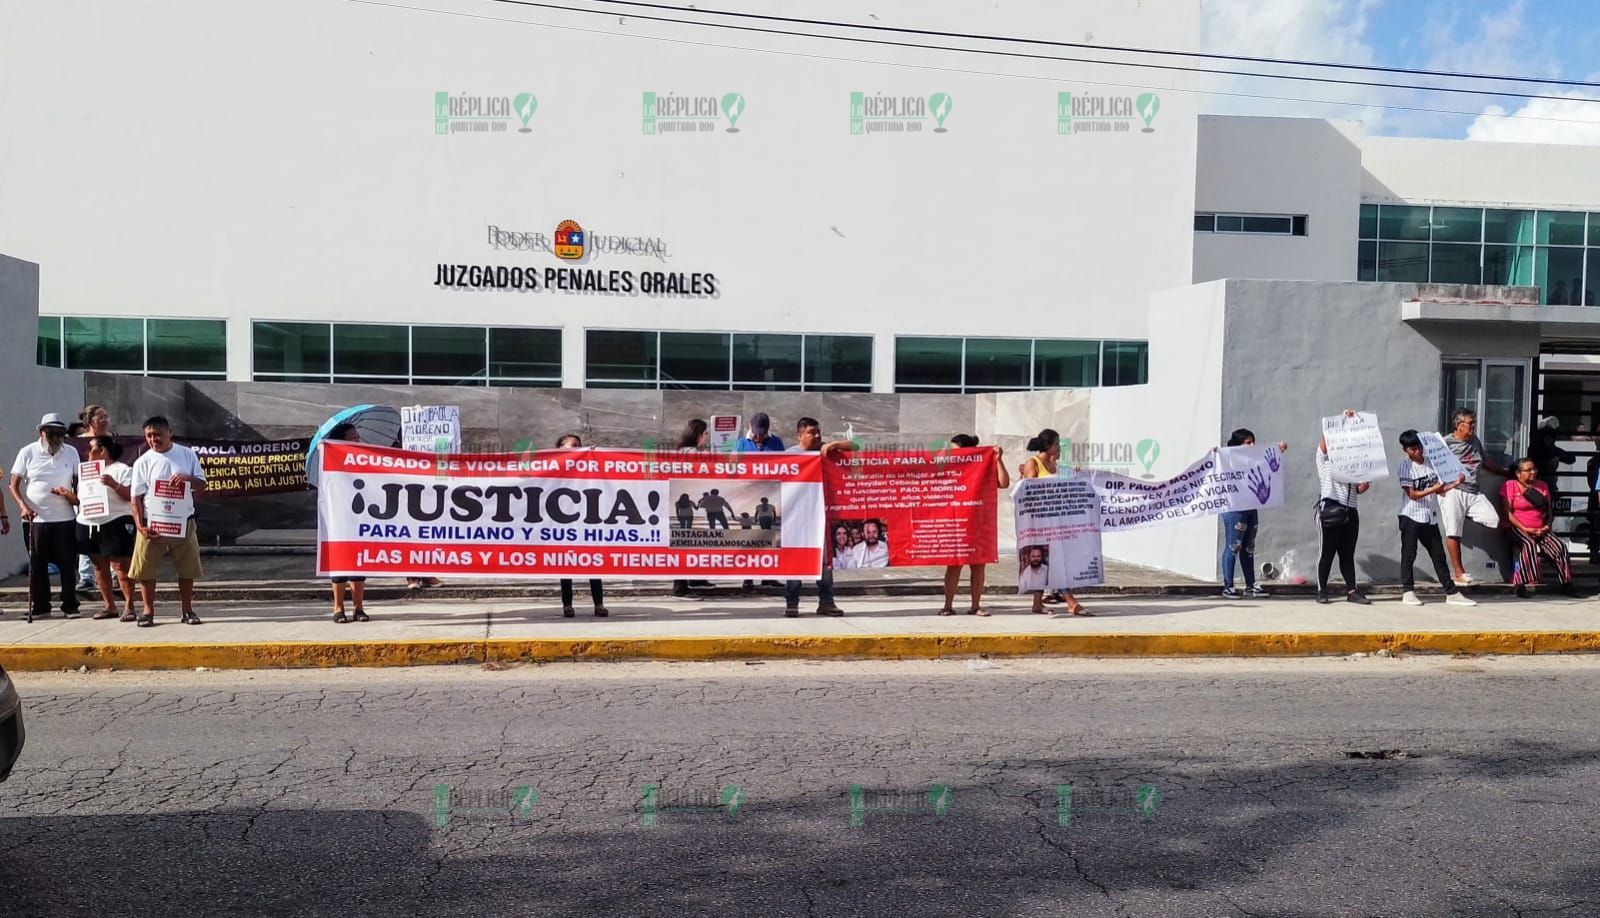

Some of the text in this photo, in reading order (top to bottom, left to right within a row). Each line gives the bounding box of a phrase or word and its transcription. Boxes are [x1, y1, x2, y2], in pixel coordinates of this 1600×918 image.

[487, 225, 667, 257] PODER JUDICIAL
[434, 263, 716, 295] JUZGADOS PENALES ORALES
[404, 423, 450, 437] MORENO
[191, 442, 301, 455] PAOLA MORENO
[207, 456, 226, 465] POR
[229, 455, 266, 465] FRAUDE
[268, 453, 306, 463] PROCES
[343, 452, 800, 476] ACUSADO DE VIOLENCIA POR PROTEGER A SUS HIJAS
[836, 457, 890, 467] JUSTICIA
[893, 456, 926, 465] PARA
[204, 466, 237, 478] LENICA
[239, 465, 251, 476] EN
[253, 463, 292, 474] CONTRA
[264, 477, 277, 487] LA
[1105, 481, 1126, 490] DIP.
[351, 478, 660, 524] ¡JUSTICIA!
[867, 494, 897, 502] durante
[1163, 490, 1171, 499] A
[1100, 504, 1145, 515] ECIENDO
[1148, 491, 1204, 512] VIOLENCIA
[1103, 518, 1116, 528] AL
[1118, 512, 1164, 526] AMPARO
[1166, 508, 1186, 520] DEL
[358, 523, 411, 538] PARA
[418, 526, 515, 540] EMILIANO
[521, 527, 533, 541] Y
[540, 527, 577, 541] SUS
[671, 530, 725, 538] INSTAGRAM:
[356, 548, 779, 569] ¡LAS NIÑAS Y LOS NIÑOS TIENEN DERECHO!
